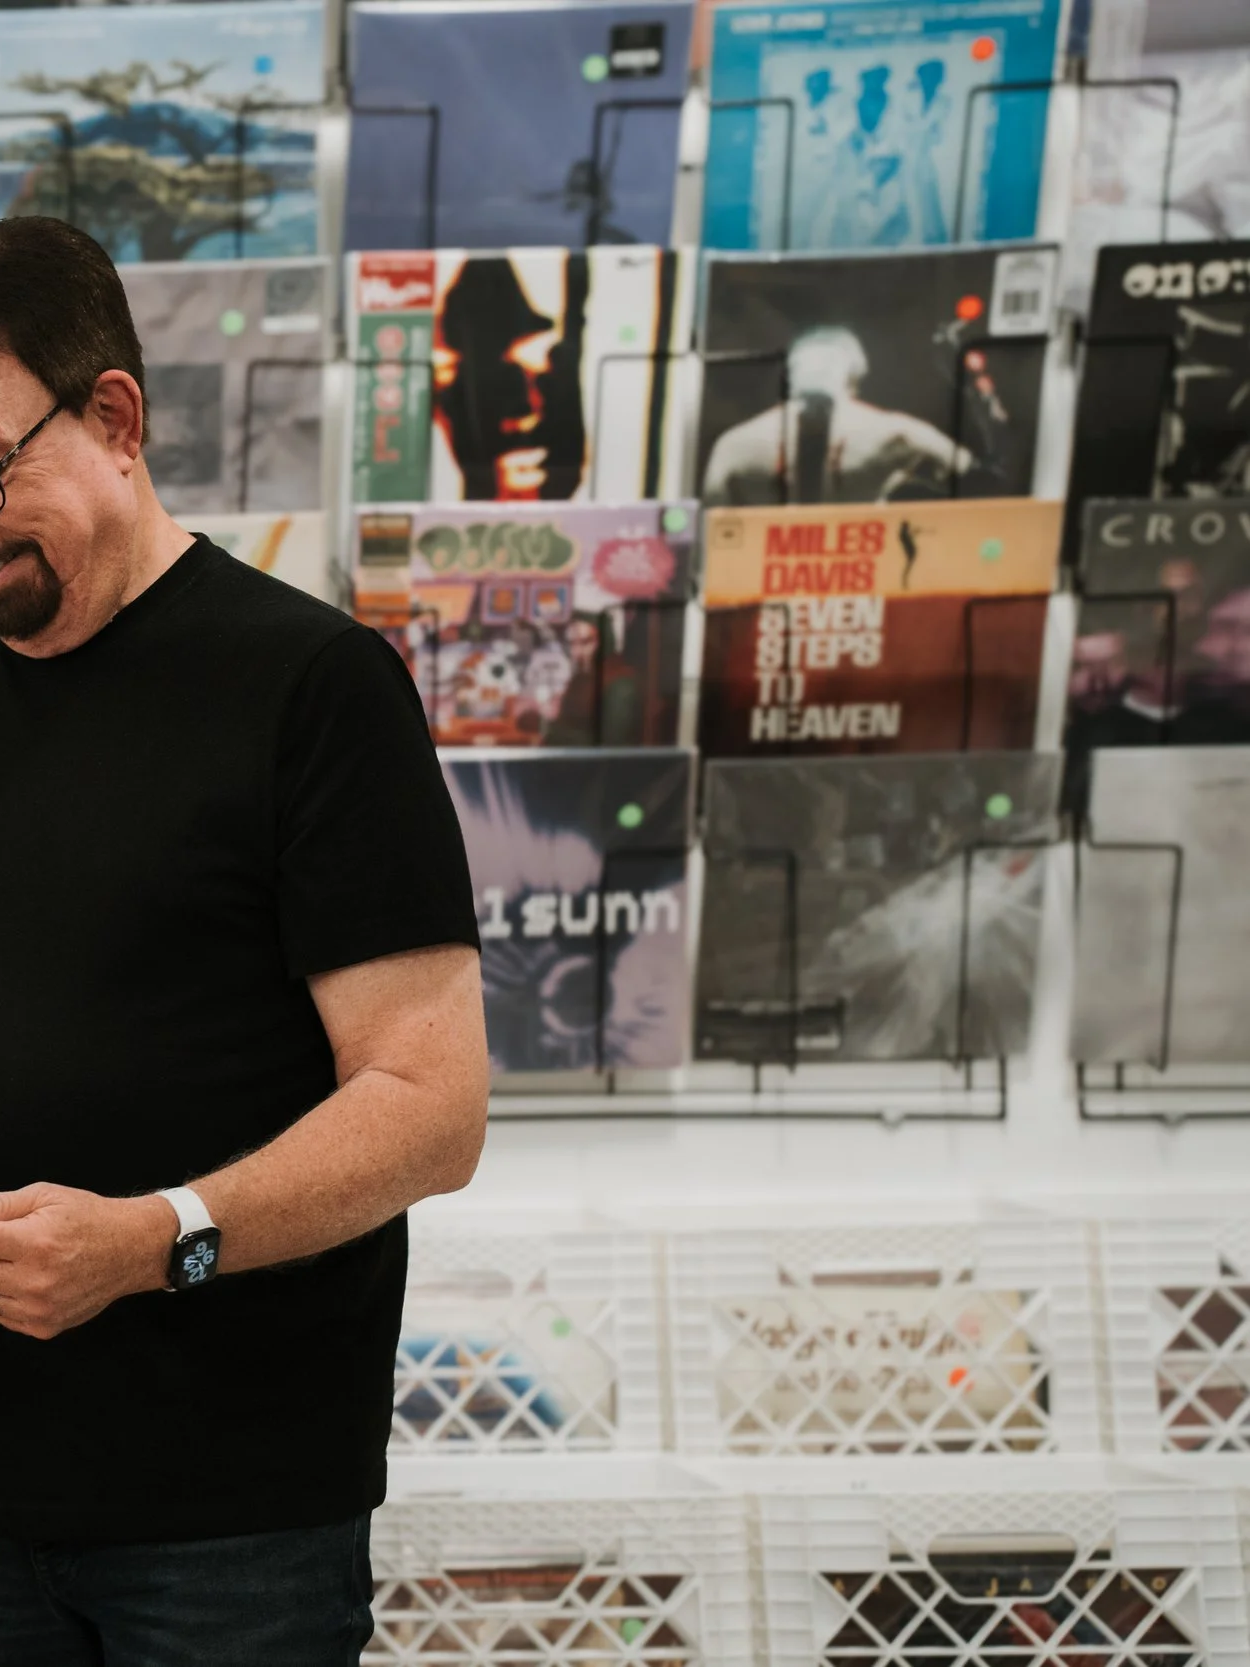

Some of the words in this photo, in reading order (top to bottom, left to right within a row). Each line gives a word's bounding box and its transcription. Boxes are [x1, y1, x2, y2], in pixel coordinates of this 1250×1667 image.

[766, 520, 886, 557] MILES
[763, 559, 877, 596] DAVIS
[760, 595, 885, 633] SEVEN
[756, 631, 882, 670] STEPS
[750, 702, 901, 741] HEAVEN
